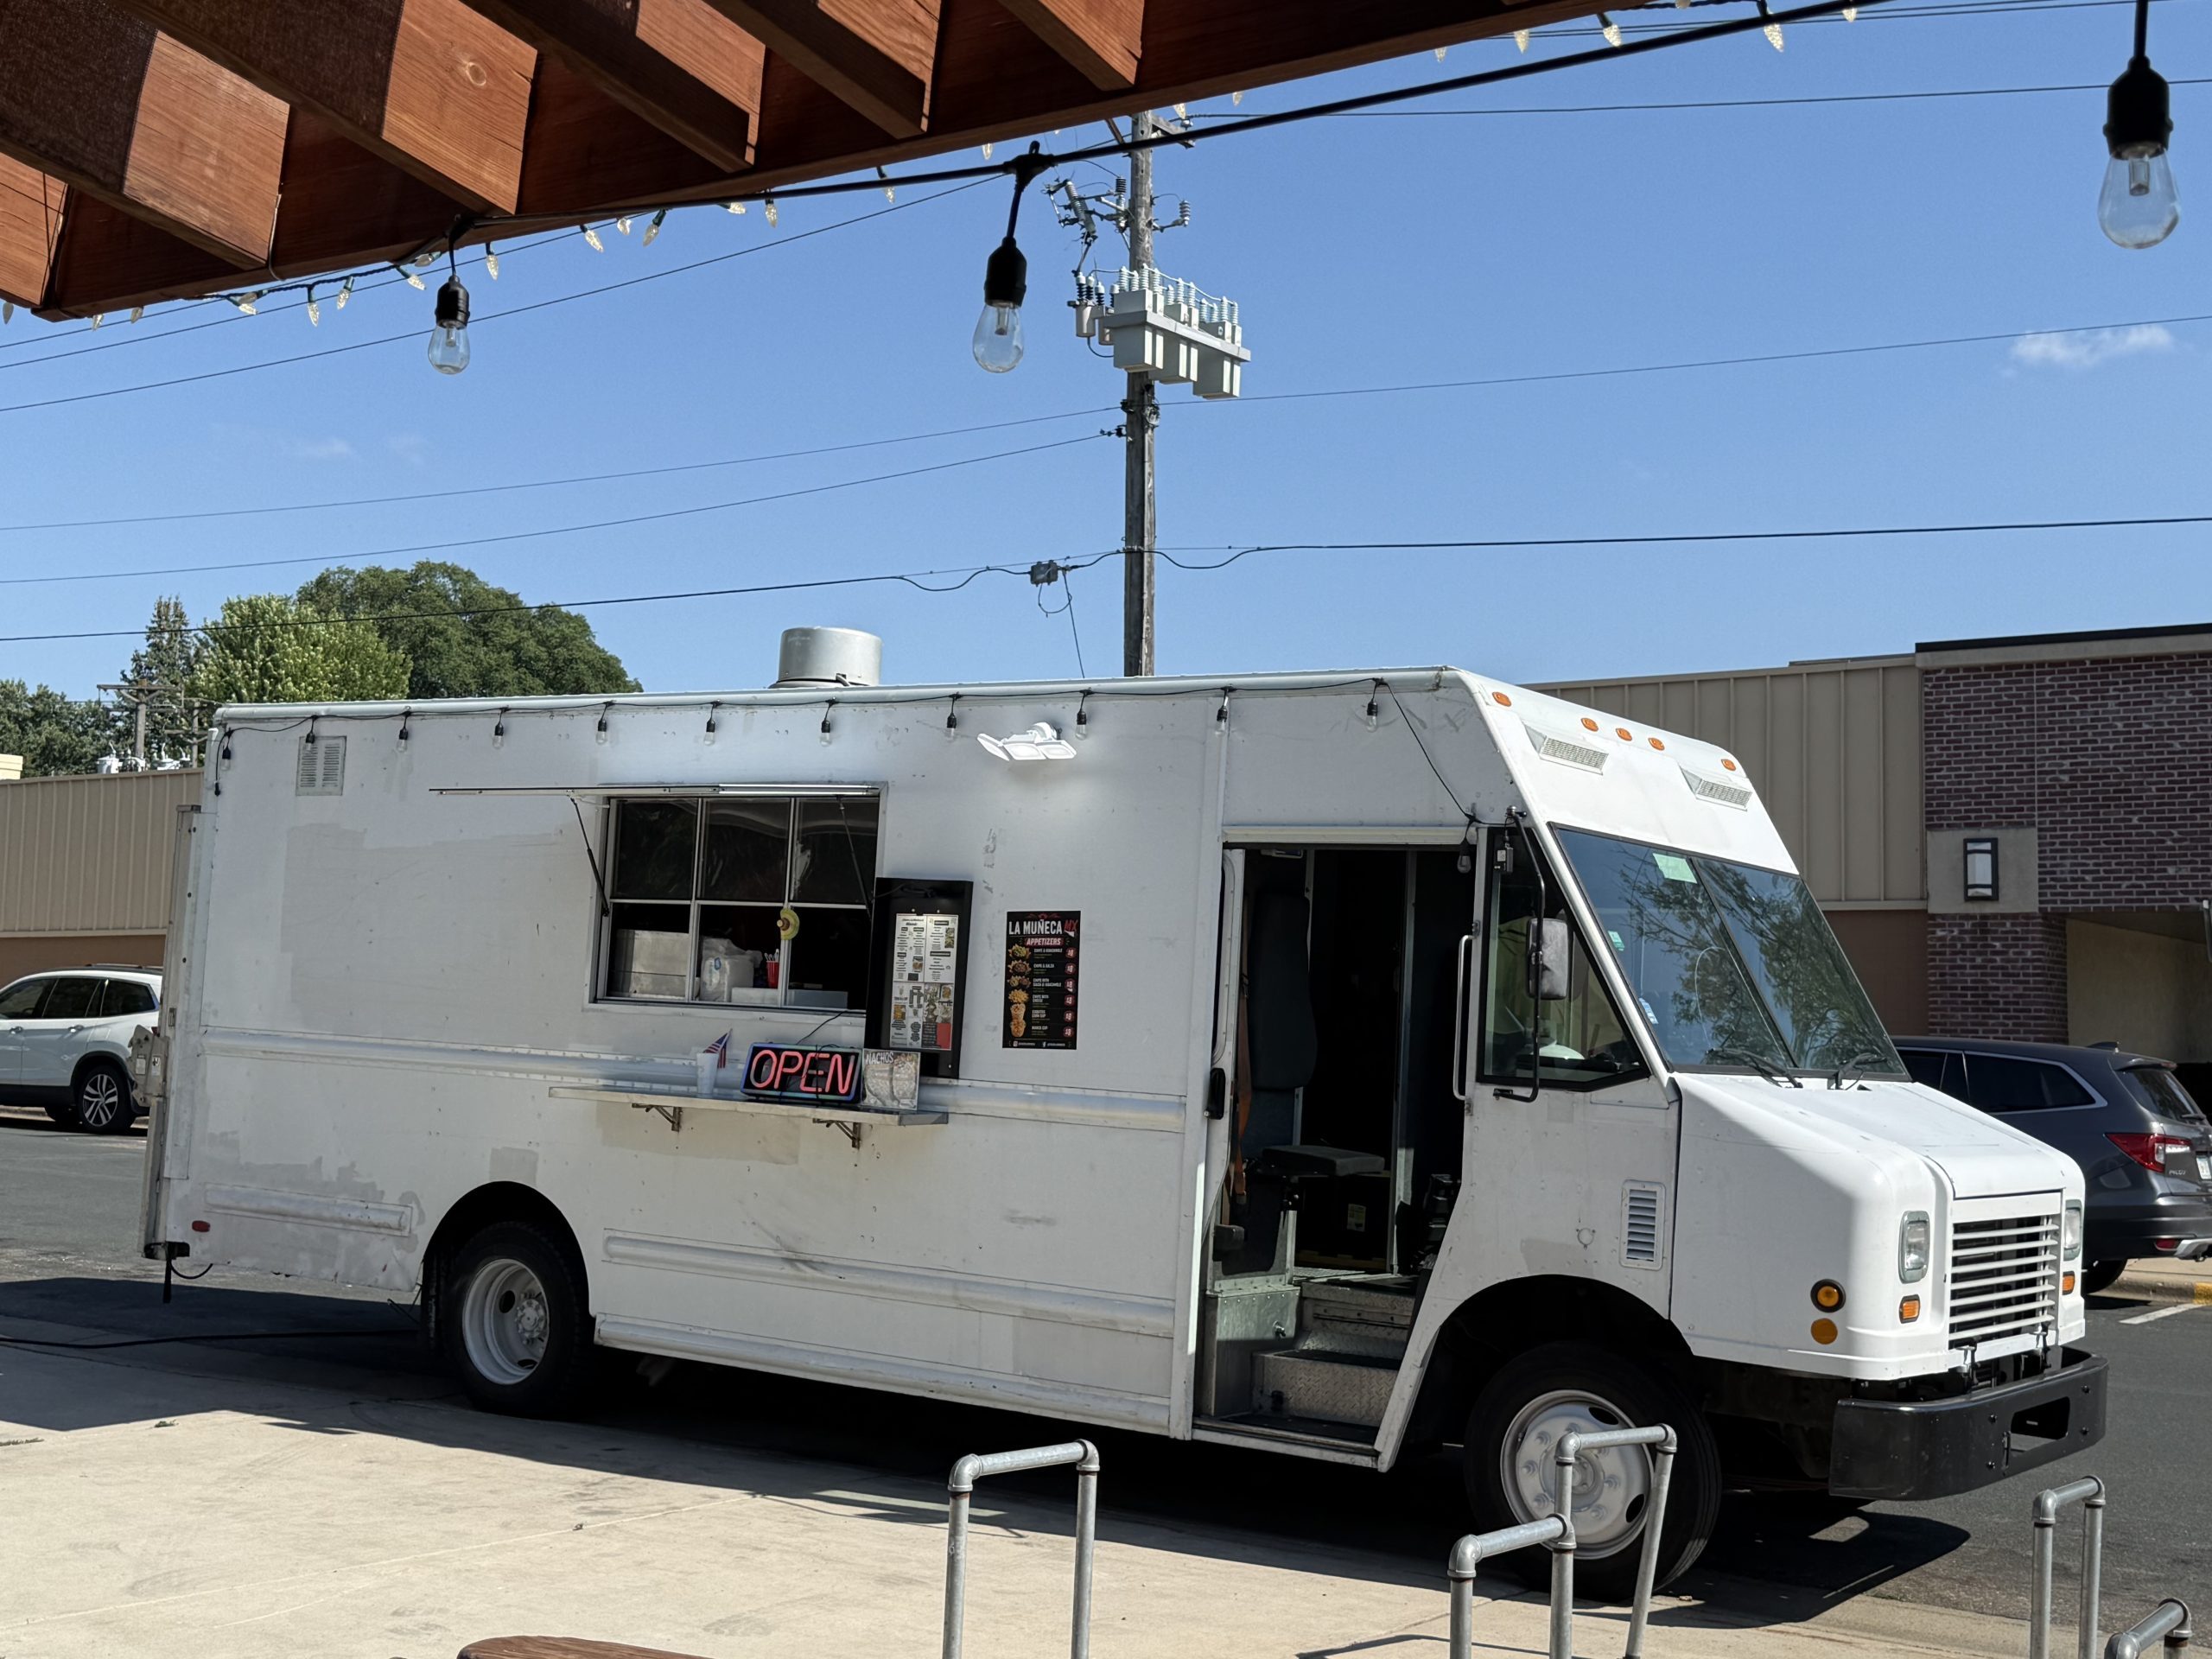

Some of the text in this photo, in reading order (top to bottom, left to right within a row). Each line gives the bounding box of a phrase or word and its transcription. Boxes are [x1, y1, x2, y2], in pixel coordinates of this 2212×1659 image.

[1008, 921, 1020, 935] LA
[1023, 919, 1063, 935] MUÑECA
[1027, 938, 1062, 946] APPETIZERS
[866, 1052, 894, 1065] NACHOS
[749, 1049, 855, 1095] OPEN
